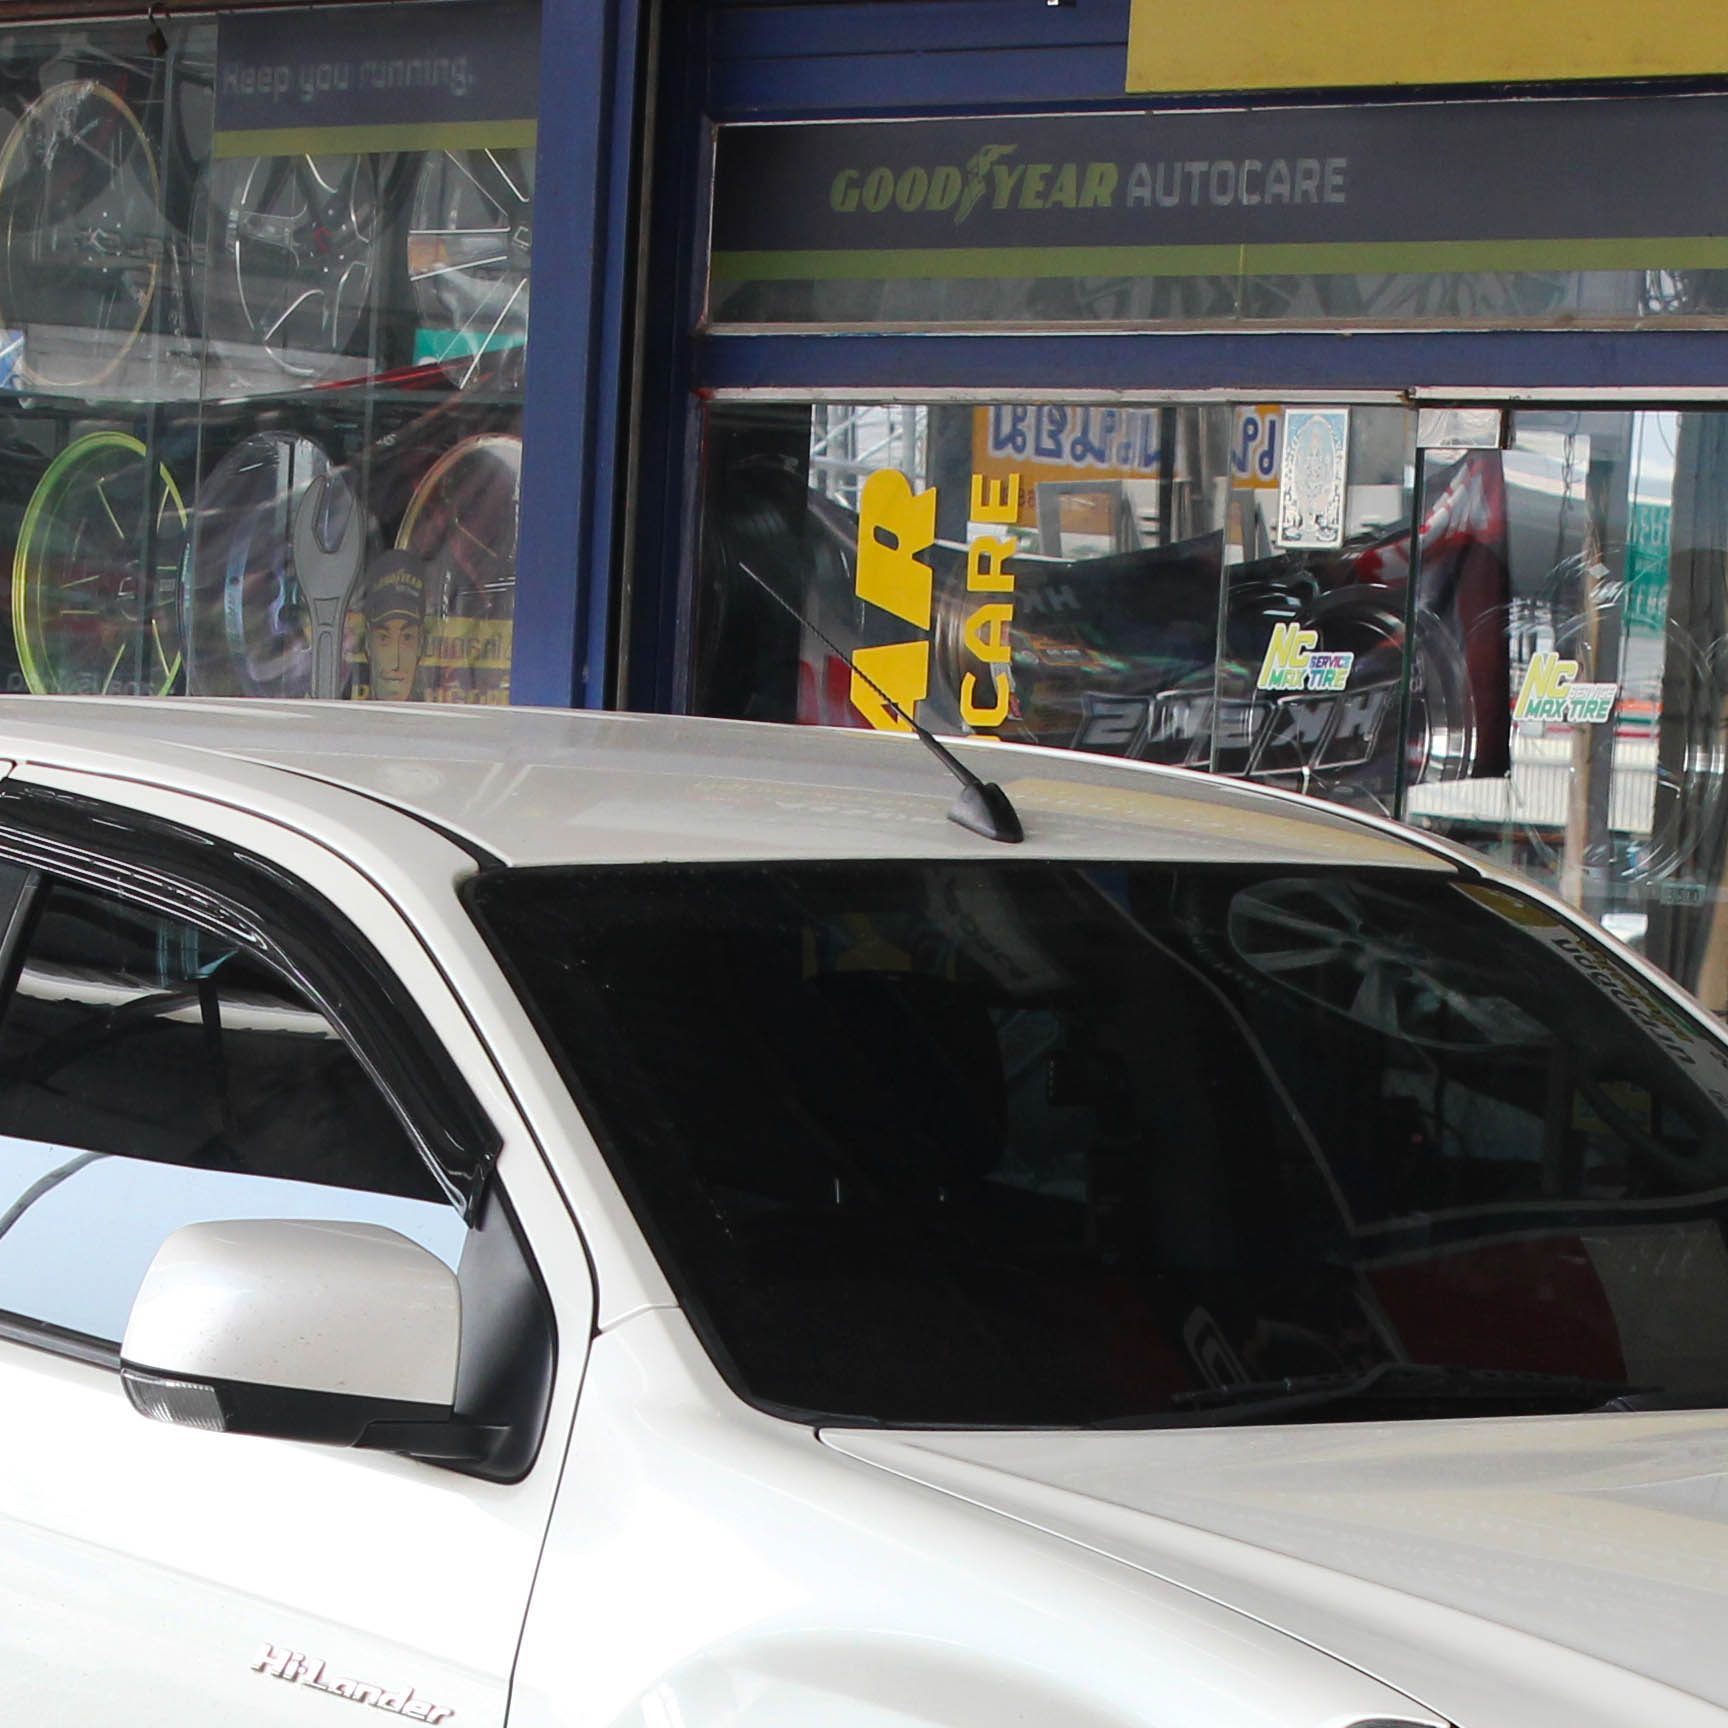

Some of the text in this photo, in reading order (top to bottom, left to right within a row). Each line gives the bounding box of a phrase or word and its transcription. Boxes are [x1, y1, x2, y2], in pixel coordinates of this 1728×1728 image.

[829, 150, 1348, 216] GOODYEAR AUTOCARE
[960, 472, 1020, 740] CARE
[1260, 624, 1317, 685] NC
[1270, 668, 1347, 690] MAX TIRE
[1516, 655, 1576, 718] NC
[1527, 698, 1611, 720] MAX TIRE
